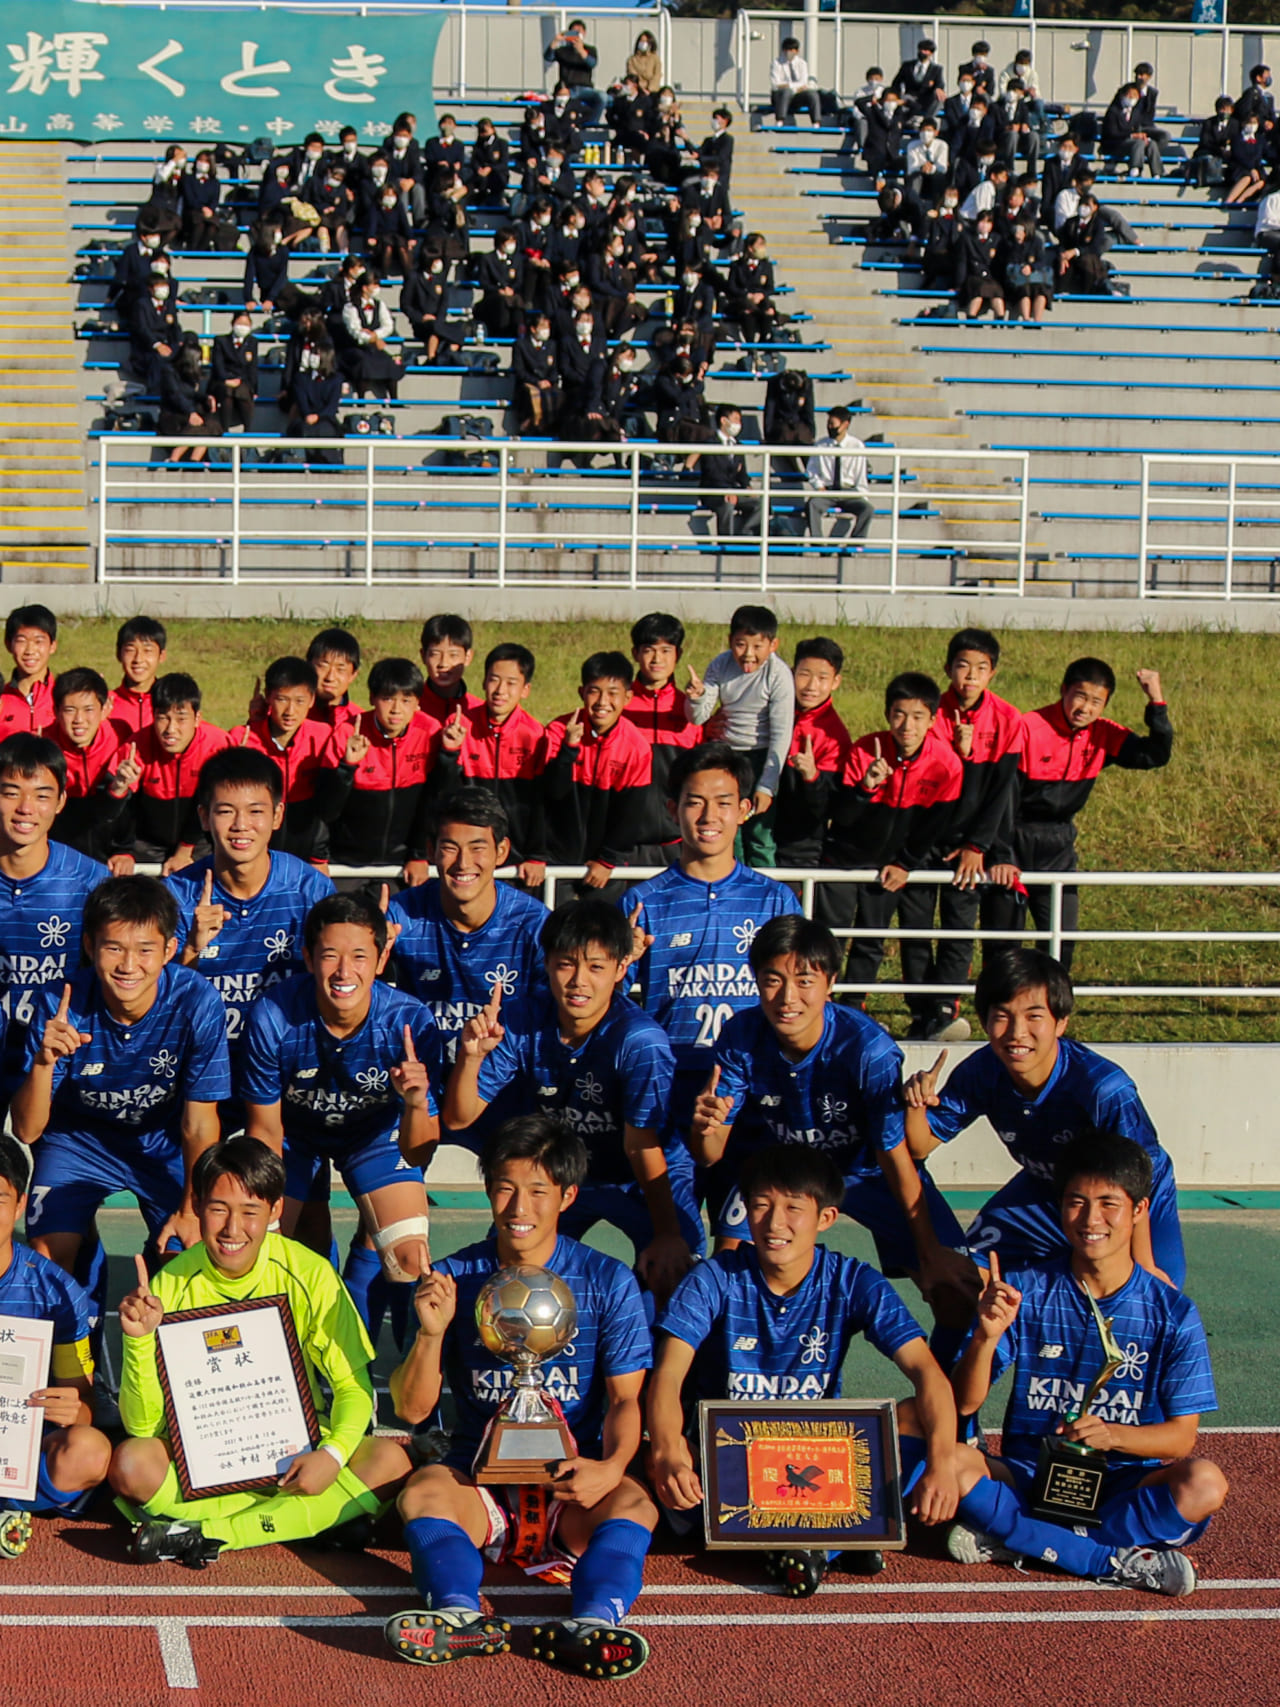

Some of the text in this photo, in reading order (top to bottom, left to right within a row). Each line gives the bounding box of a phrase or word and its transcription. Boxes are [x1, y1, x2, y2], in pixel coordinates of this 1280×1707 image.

[668, 963, 756, 985] KINDA
[1, 989, 35, 1024] 16
[225, 1008, 245, 1039] 2
[694, 1002, 735, 1047] 20
[726, 1191, 747, 1226] 6
[728, 1372, 831, 1395] KINDAI
